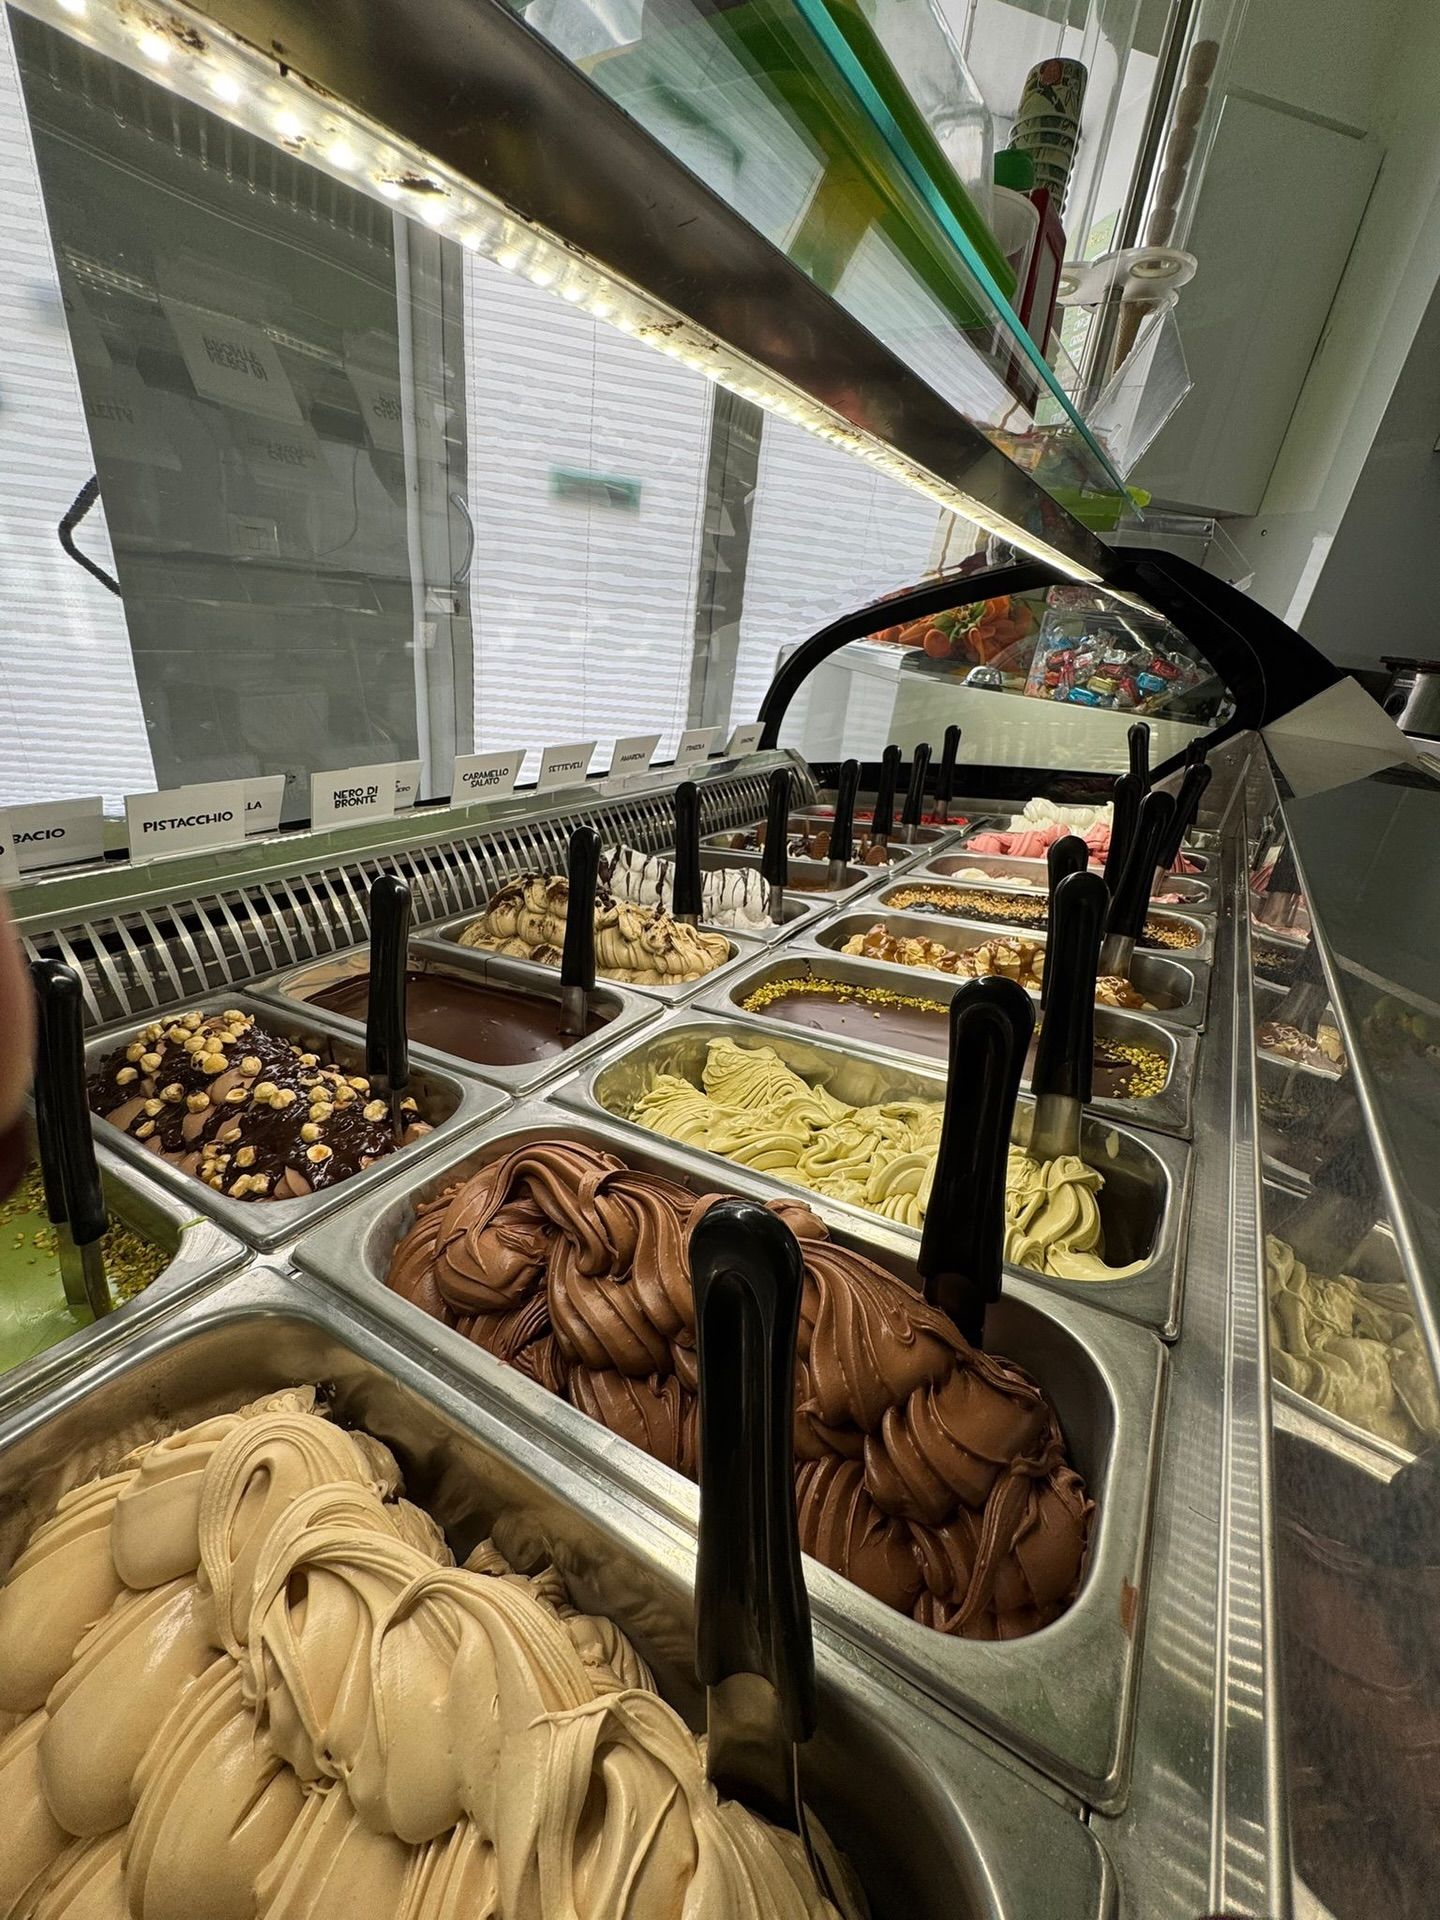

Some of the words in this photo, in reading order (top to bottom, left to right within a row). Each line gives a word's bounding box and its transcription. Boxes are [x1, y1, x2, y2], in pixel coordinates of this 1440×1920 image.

[463, 768, 509, 781] CARAMELLO
[471, 776, 500, 788] SALATO
[333, 787, 363, 800] NERO
[367, 785, 378, 795] DI
[244, 801, 262, 811] LA
[335, 794, 377, 808] BRONTE
[143, 811, 233, 832] PISTACCHIO
[12, 828, 65, 844] BACIO
